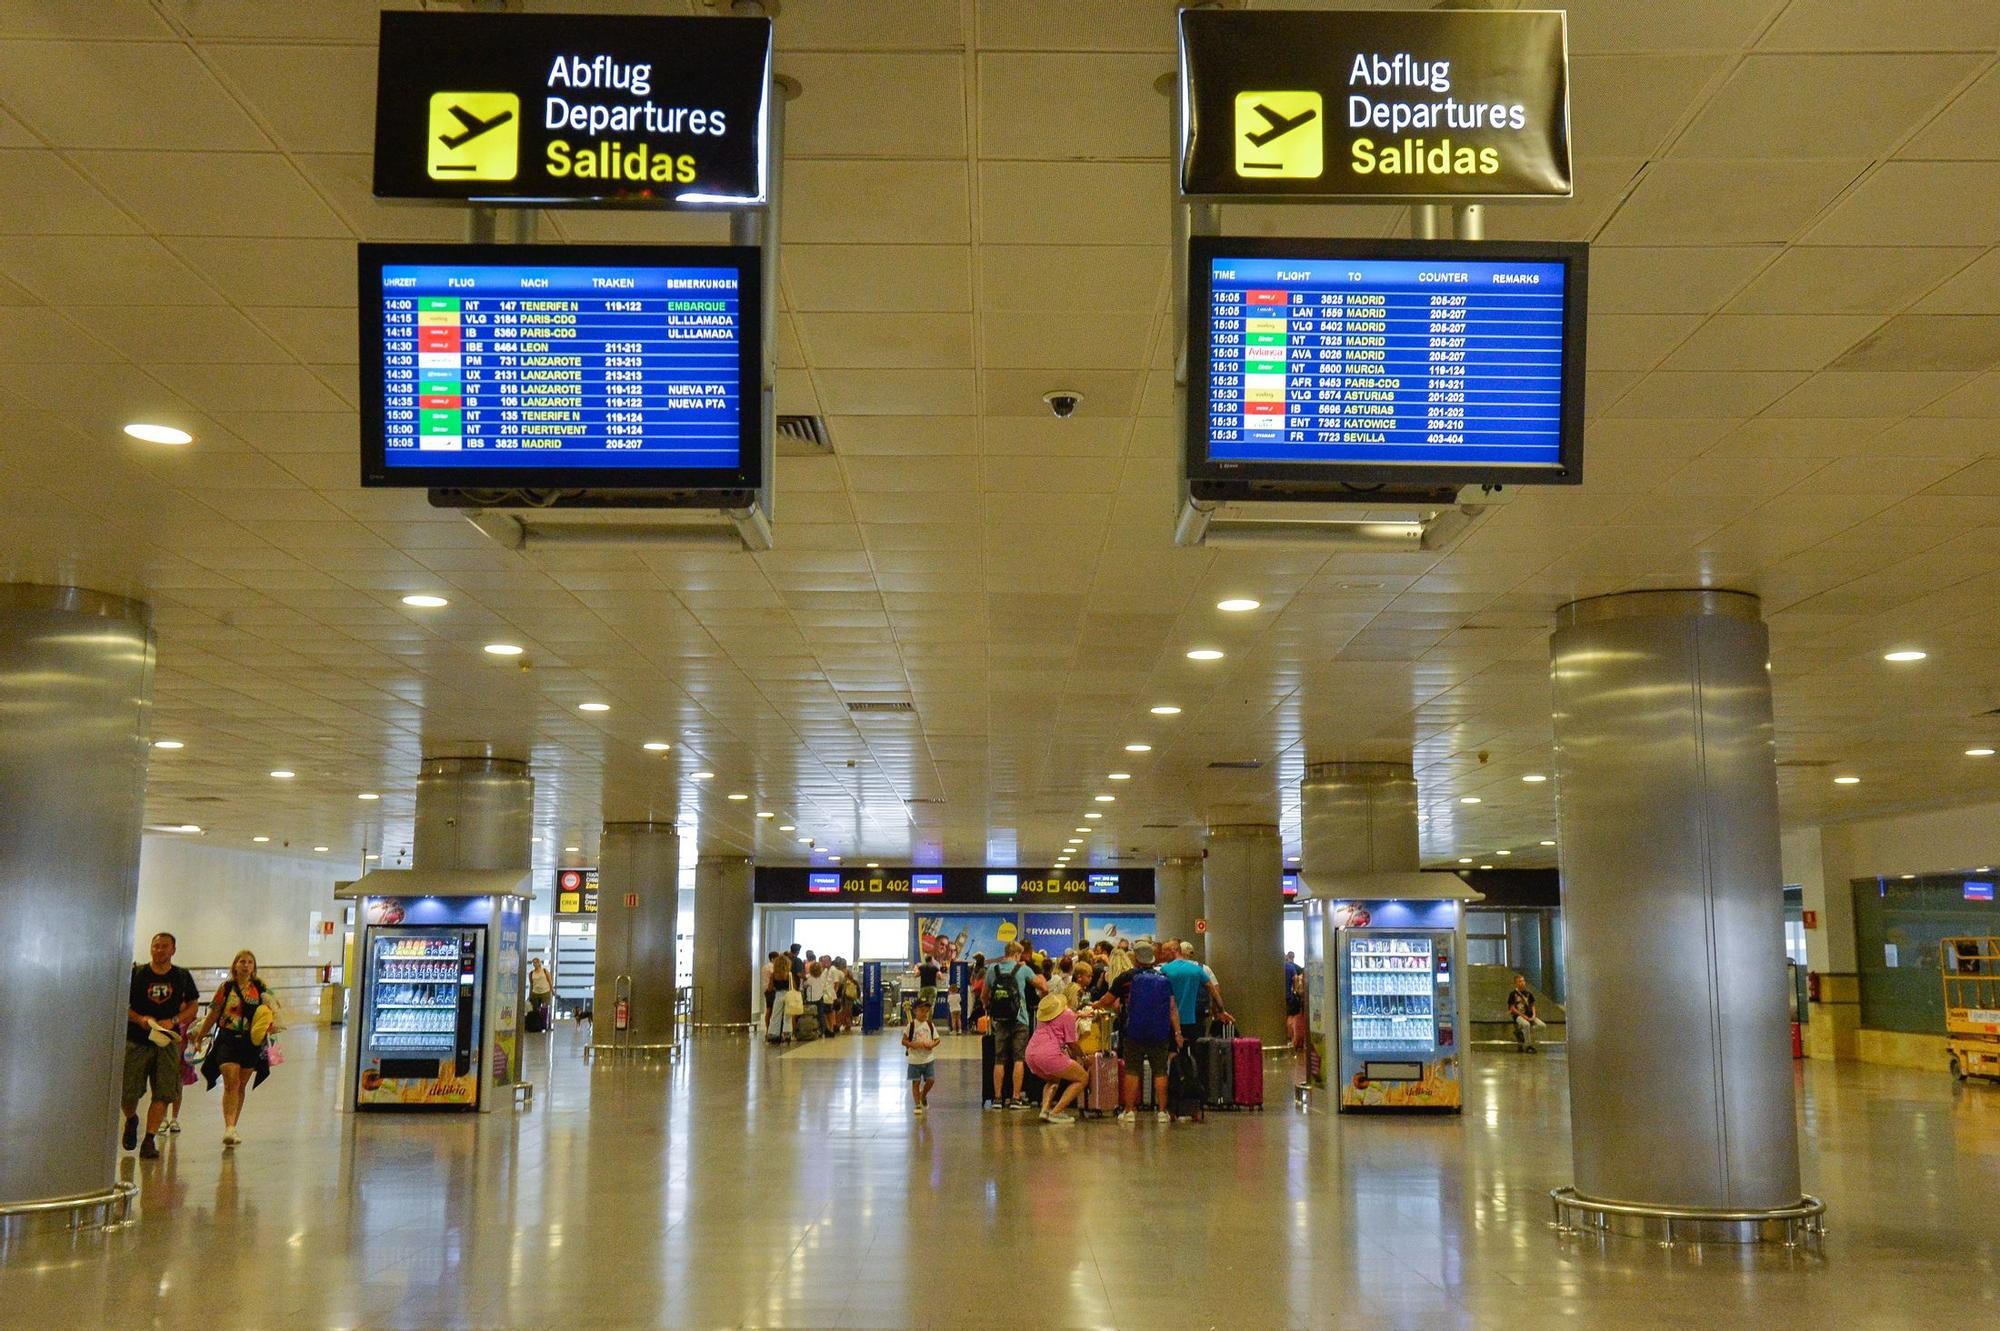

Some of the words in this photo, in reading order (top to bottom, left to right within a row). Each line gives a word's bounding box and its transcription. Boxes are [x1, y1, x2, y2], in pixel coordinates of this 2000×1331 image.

[547, 55, 651, 95] Abflug
[1349, 54, 1450, 93] Abflug
[545, 97, 726, 136] Departures
[1349, 96, 1526, 133] Departures
[546, 139, 697, 184] Salidas
[1351, 138, 1499, 175] Salidas
[1215, 270, 1236, 280] TIME
[1276, 271, 1311, 281] FLIGHT
[1348, 272, 1362, 282] TO
[1418, 272, 1468, 283] COUNTER
[1492, 274, 1540, 284] REMARKS
[384, 278, 417, 287] UHRZEIT
[448, 278, 475, 287] FLUG
[520, 278, 549, 288] NACH
[667, 279, 738, 289] BEMERKUNGEN
[1214, 292, 1240, 303] 15:05
[1292, 294, 1303, 304] IB
[1321, 294, 1344, 305] 3825
[1346, 295, 1386, 305] MADRID
[386, 300, 412, 310] 14:00
[465, 301, 480, 311] NT
[500, 301, 517, 311] 147
[520, 301, 569, 311] TENERIFE
[570, 302, 579, 311] N
[667, 301, 726, 312] EMBARQUE
[1214, 306, 1240, 316] 15:05
[1292, 307, 1313, 317] LAN
[1346, 308, 1386, 318] MADRID
[386, 313, 412, 323] 14:15
[465, 314, 487, 324] VLG
[520, 314, 577, 324] PARIS-CDG
[1214, 319, 1240, 330] 15:05
[1292, 321, 1313, 331] VLG
[1320, 321, 1343, 332] 5402
[1346, 321, 1386, 332] MADRID
[386, 327, 412, 337] 14:15
[465, 328, 477, 338] IB
[520, 328, 577, 338] PARIS-CDG
[1214, 334, 1239, 344] 15:05
[1292, 335, 1306, 345] NT
[1346, 336, 1386, 346] MADRID
[386, 341, 412, 351] 14:30
[466, 342, 483, 352] IBE
[520, 342, 549, 352] LEON
[605, 343, 642, 353] 211-212
[1213, 348, 1239, 358] 15:05
[1291, 349, 1312, 359] AVA
[1345, 350, 1385, 361] MADRID
[387, 355, 413, 365] 14:30
[466, 356, 482, 365] PM
[499, 356, 517, 366] 731
[520, 356, 582, 367] LANZAROTE
[605, 357, 642, 367] 213-213
[1213, 362, 1239, 372] 15:10
[1291, 363, 1305, 373] NT
[1345, 364, 1385, 374] MURCIA
[387, 369, 413, 379] 14:30
[466, 370, 481, 380] UX
[494, 370, 517, 380] 2131
[520, 370, 582, 380] LANZAROTE
[605, 370, 642, 381] 213-213
[1212, 376, 1239, 386] 15:25
[1290, 377, 1312, 387] AFR
[1344, 378, 1400, 389] PARIS-CDG
[387, 383, 413, 393] 14:35
[466, 384, 481, 394] NT
[520, 384, 582, 394] LANZAROTE
[668, 385, 704, 395] NUEVA
[705, 385, 726, 395] PTA
[1212, 389, 1238, 399] 15:30
[1290, 390, 1312, 400] VLG
[1344, 391, 1395, 401] ASTURIAS
[1428, 392, 1465, 403] 201-202
[387, 397, 413, 406] 14:35
[466, 397, 478, 407] IB
[521, 397, 582, 407] LANZAROTE
[668, 398, 704, 409] NUEVA
[705, 398, 726, 409] PTA
[387, 410, 413, 420] 15:00
[466, 411, 481, 420] NT
[501, 411, 518, 421] 135
[521, 411, 570, 421] TENERIFE
[572, 411, 580, 421] N
[1212, 402, 1238, 412] 15:30
[1290, 404, 1301, 414] IB
[1343, 405, 1394, 415] ASTURIAS
[1427, 407, 1464, 419] 201-202
[1212, 417, 1238, 427] 15:35
[1290, 417, 1311, 427] ENT
[1344, 419, 1396, 429] KATOWICE
[388, 424, 413, 434] 15:00
[467, 424, 481, 434] NT
[500, 424, 518, 434] 210
[521, 425, 587, 435] FUERTEVENT
[1212, 430, 1237, 440] 15:35
[1290, 431, 1304, 441] FR
[1318, 432, 1341, 442] 7723
[1343, 432, 1386, 443] SEVILLA
[1427, 434, 1464, 444] 403-404
[388, 438, 414, 447] 15:05
[467, 438, 485, 448] IBS
[495, 439, 519, 449] 3825
[521, 439, 562, 449] MADRID
[843, 879, 865, 892] 401
[886, 879, 909, 893] 402
[1021, 880, 1044, 893] 403
[1063, 880, 1086, 893] 404
[1031, 927, 1072, 936] RYANAIR
